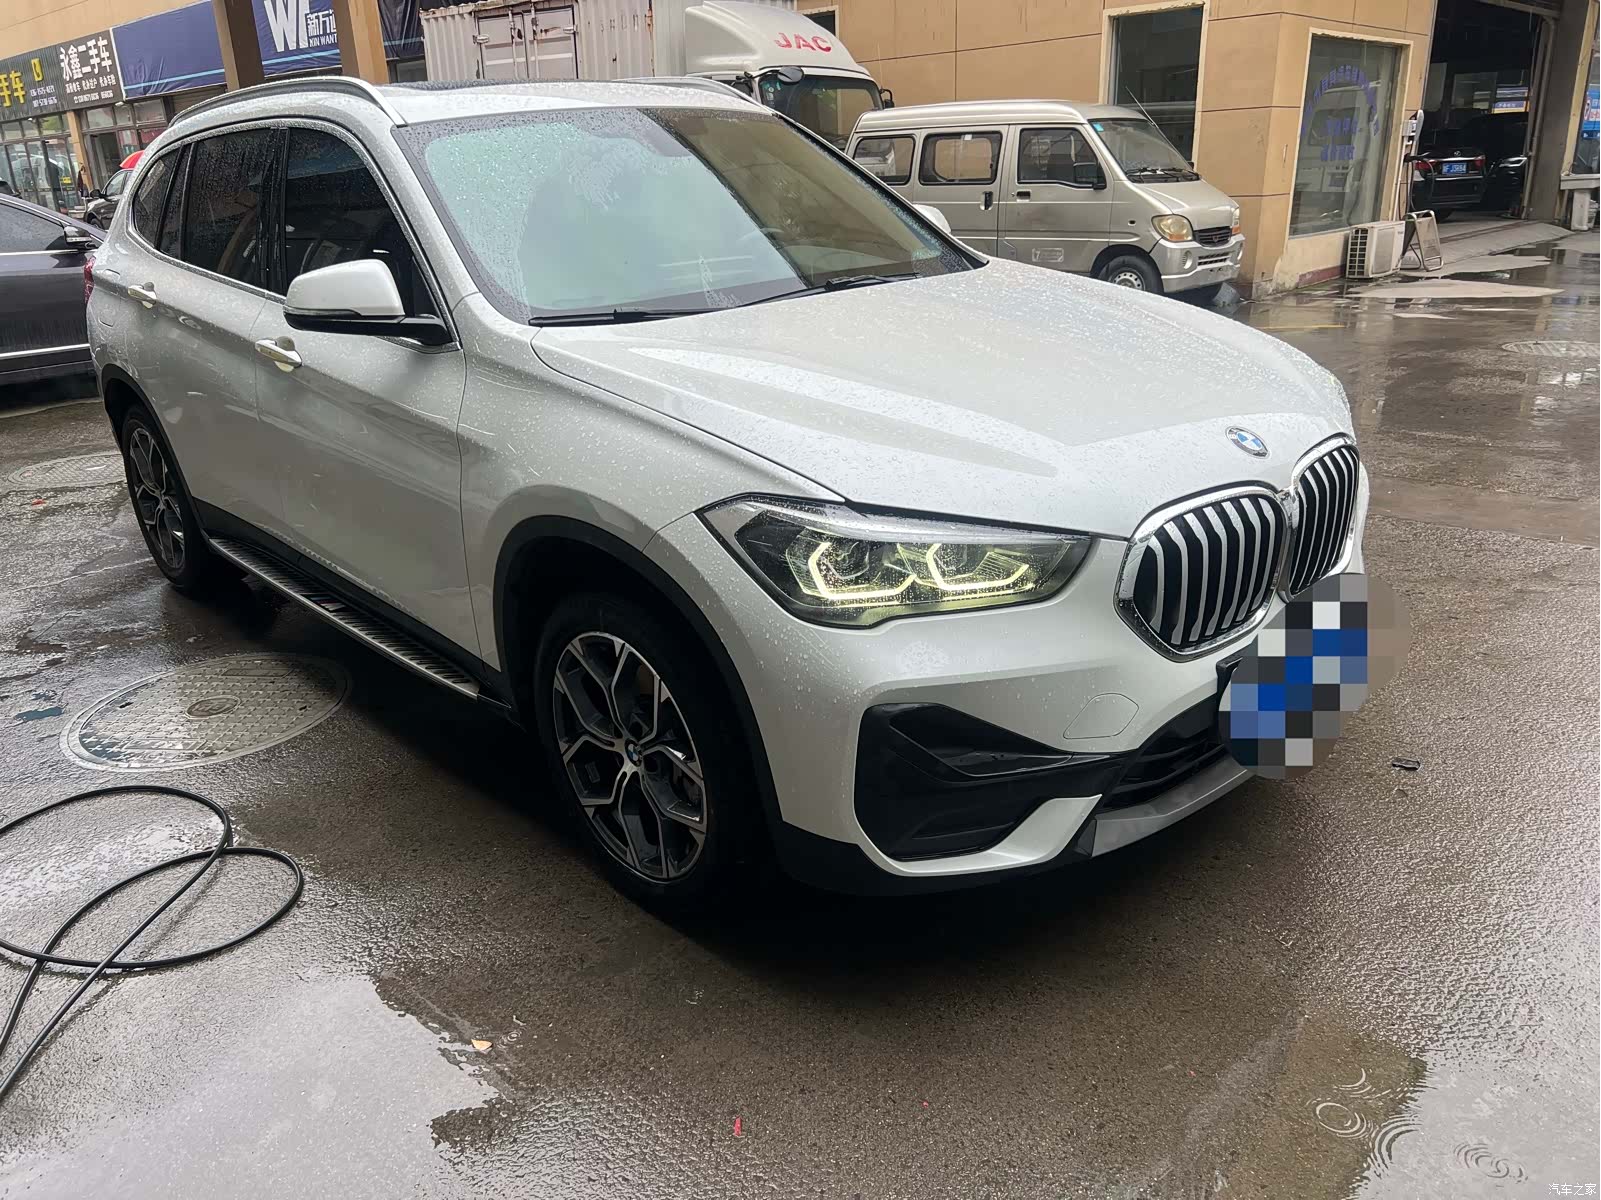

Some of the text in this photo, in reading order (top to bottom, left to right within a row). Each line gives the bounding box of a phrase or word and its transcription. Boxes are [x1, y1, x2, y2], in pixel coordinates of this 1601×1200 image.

[774, 32, 832, 53] JAC
[60, 37, 112, 82] 永鑫二手车
